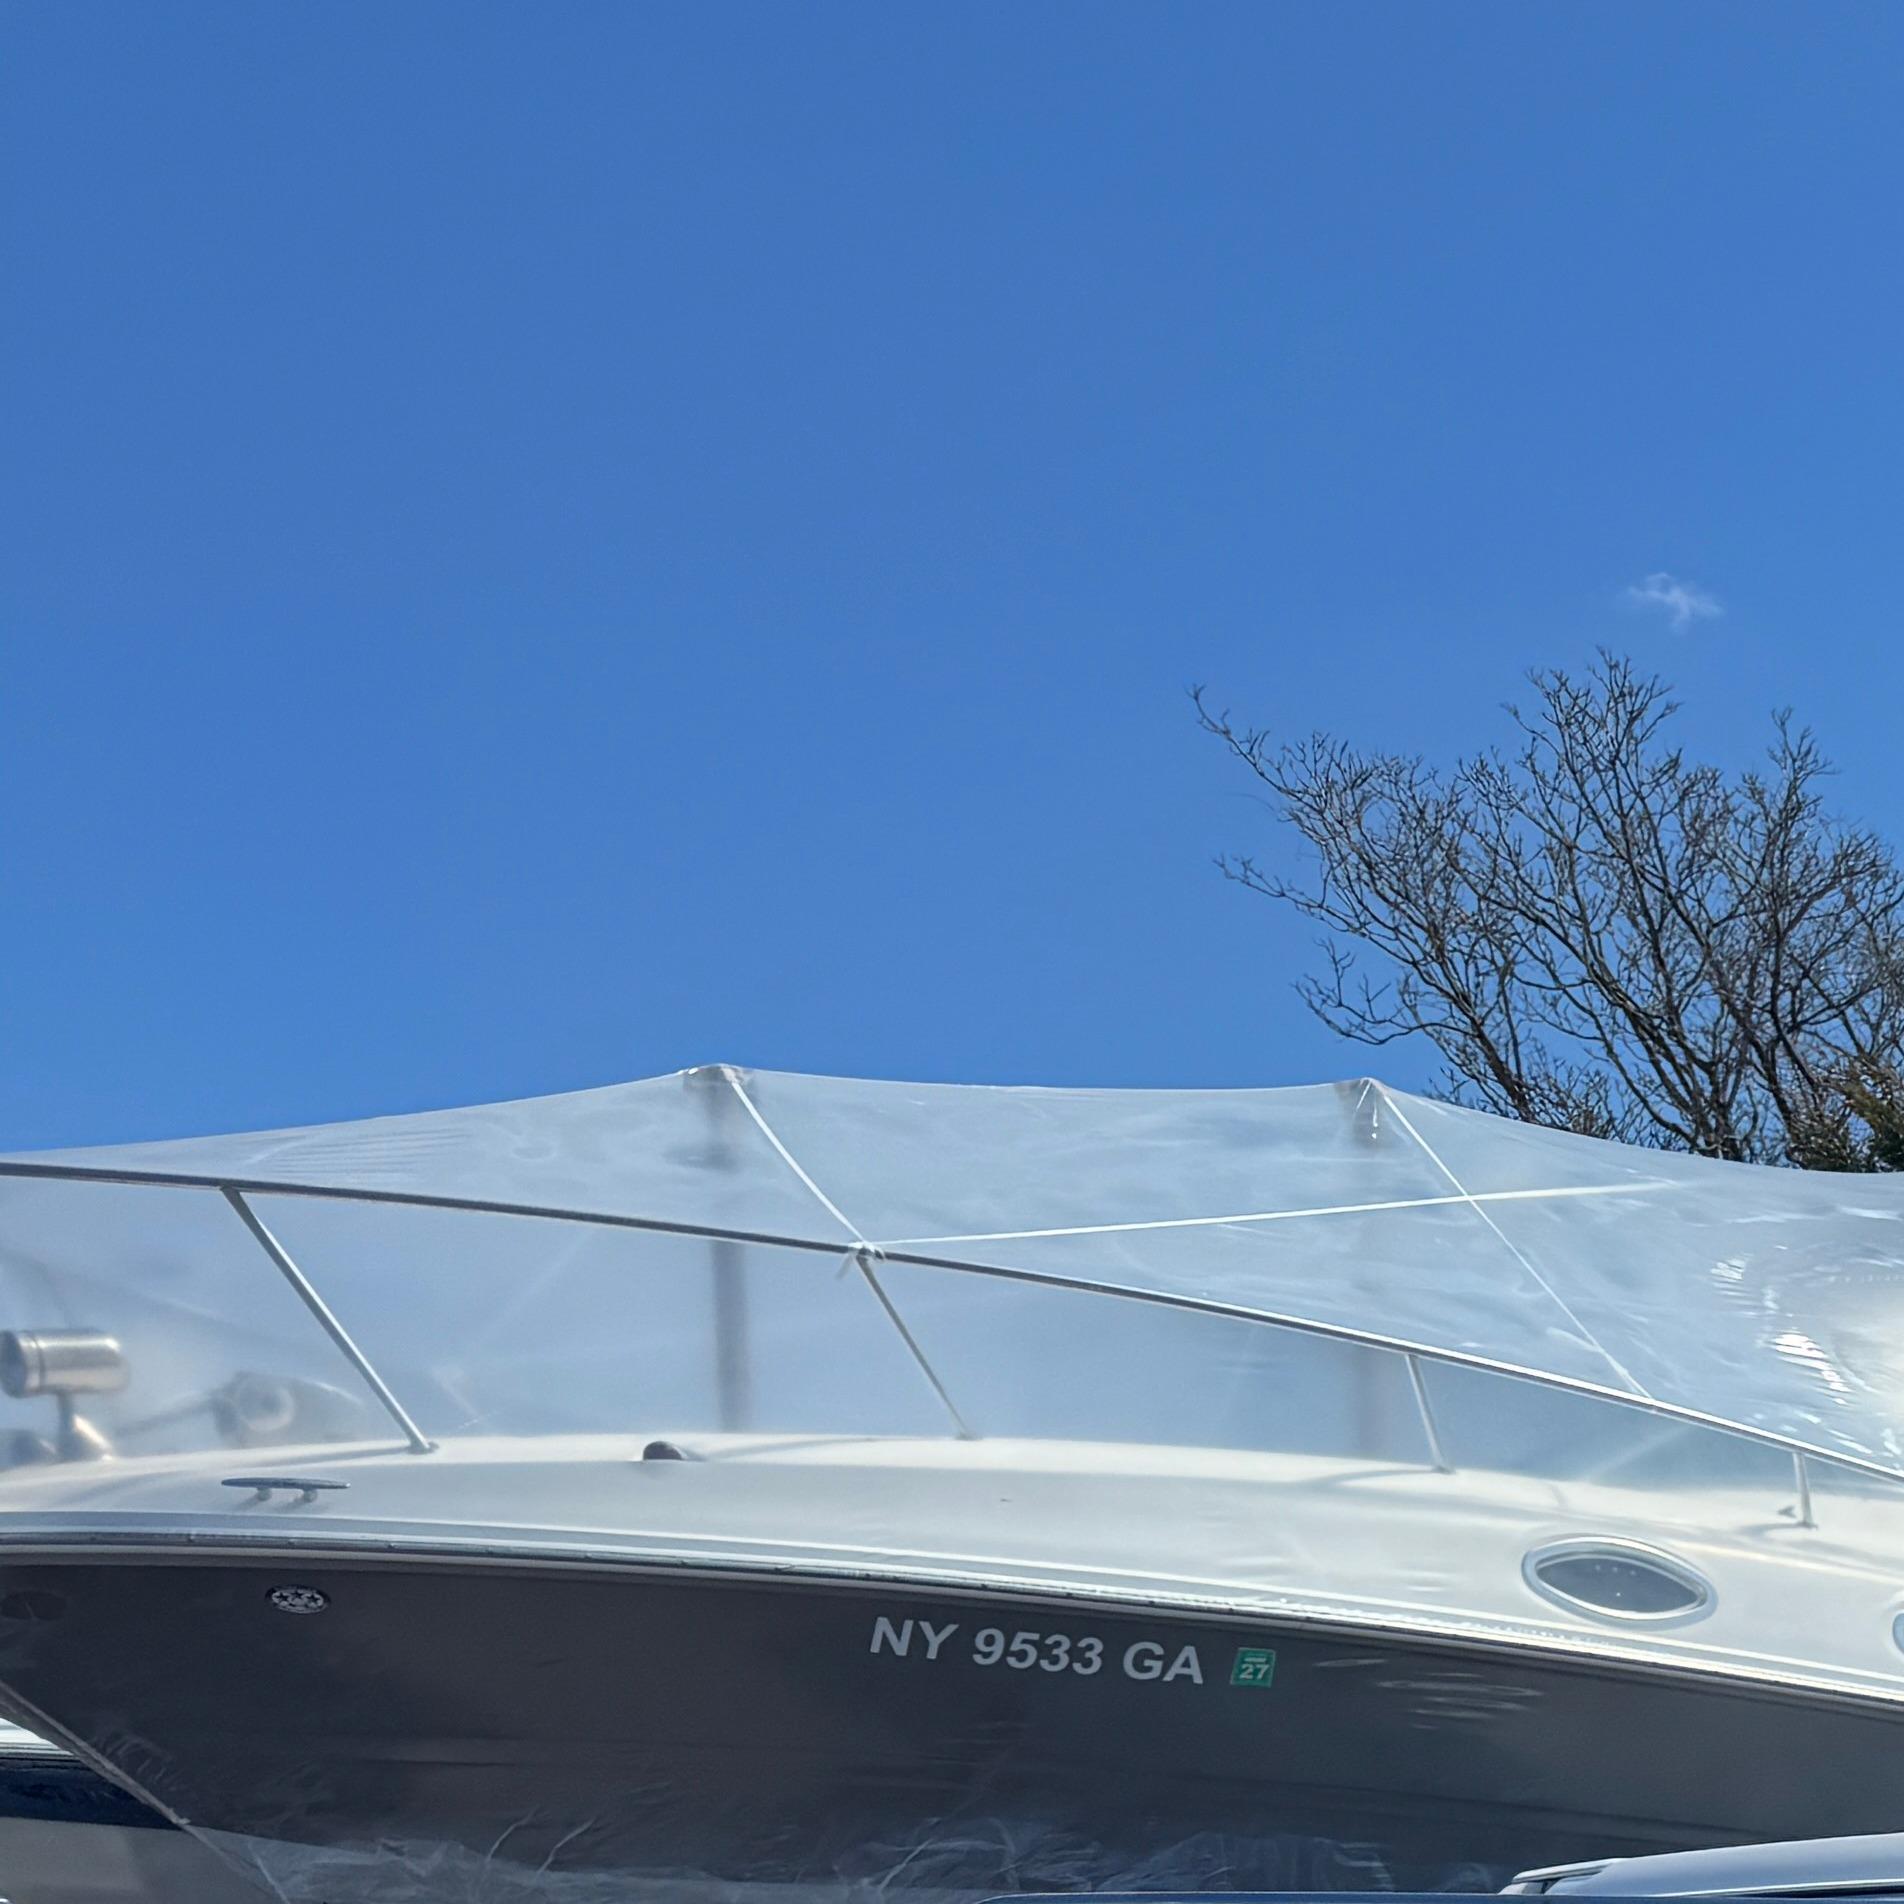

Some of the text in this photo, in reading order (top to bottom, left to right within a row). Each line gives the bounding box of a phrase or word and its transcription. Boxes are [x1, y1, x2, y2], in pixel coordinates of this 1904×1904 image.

[869, 1615, 1204, 1685] NY 9533 GA
[1239, 1663, 1270, 1680] 27
